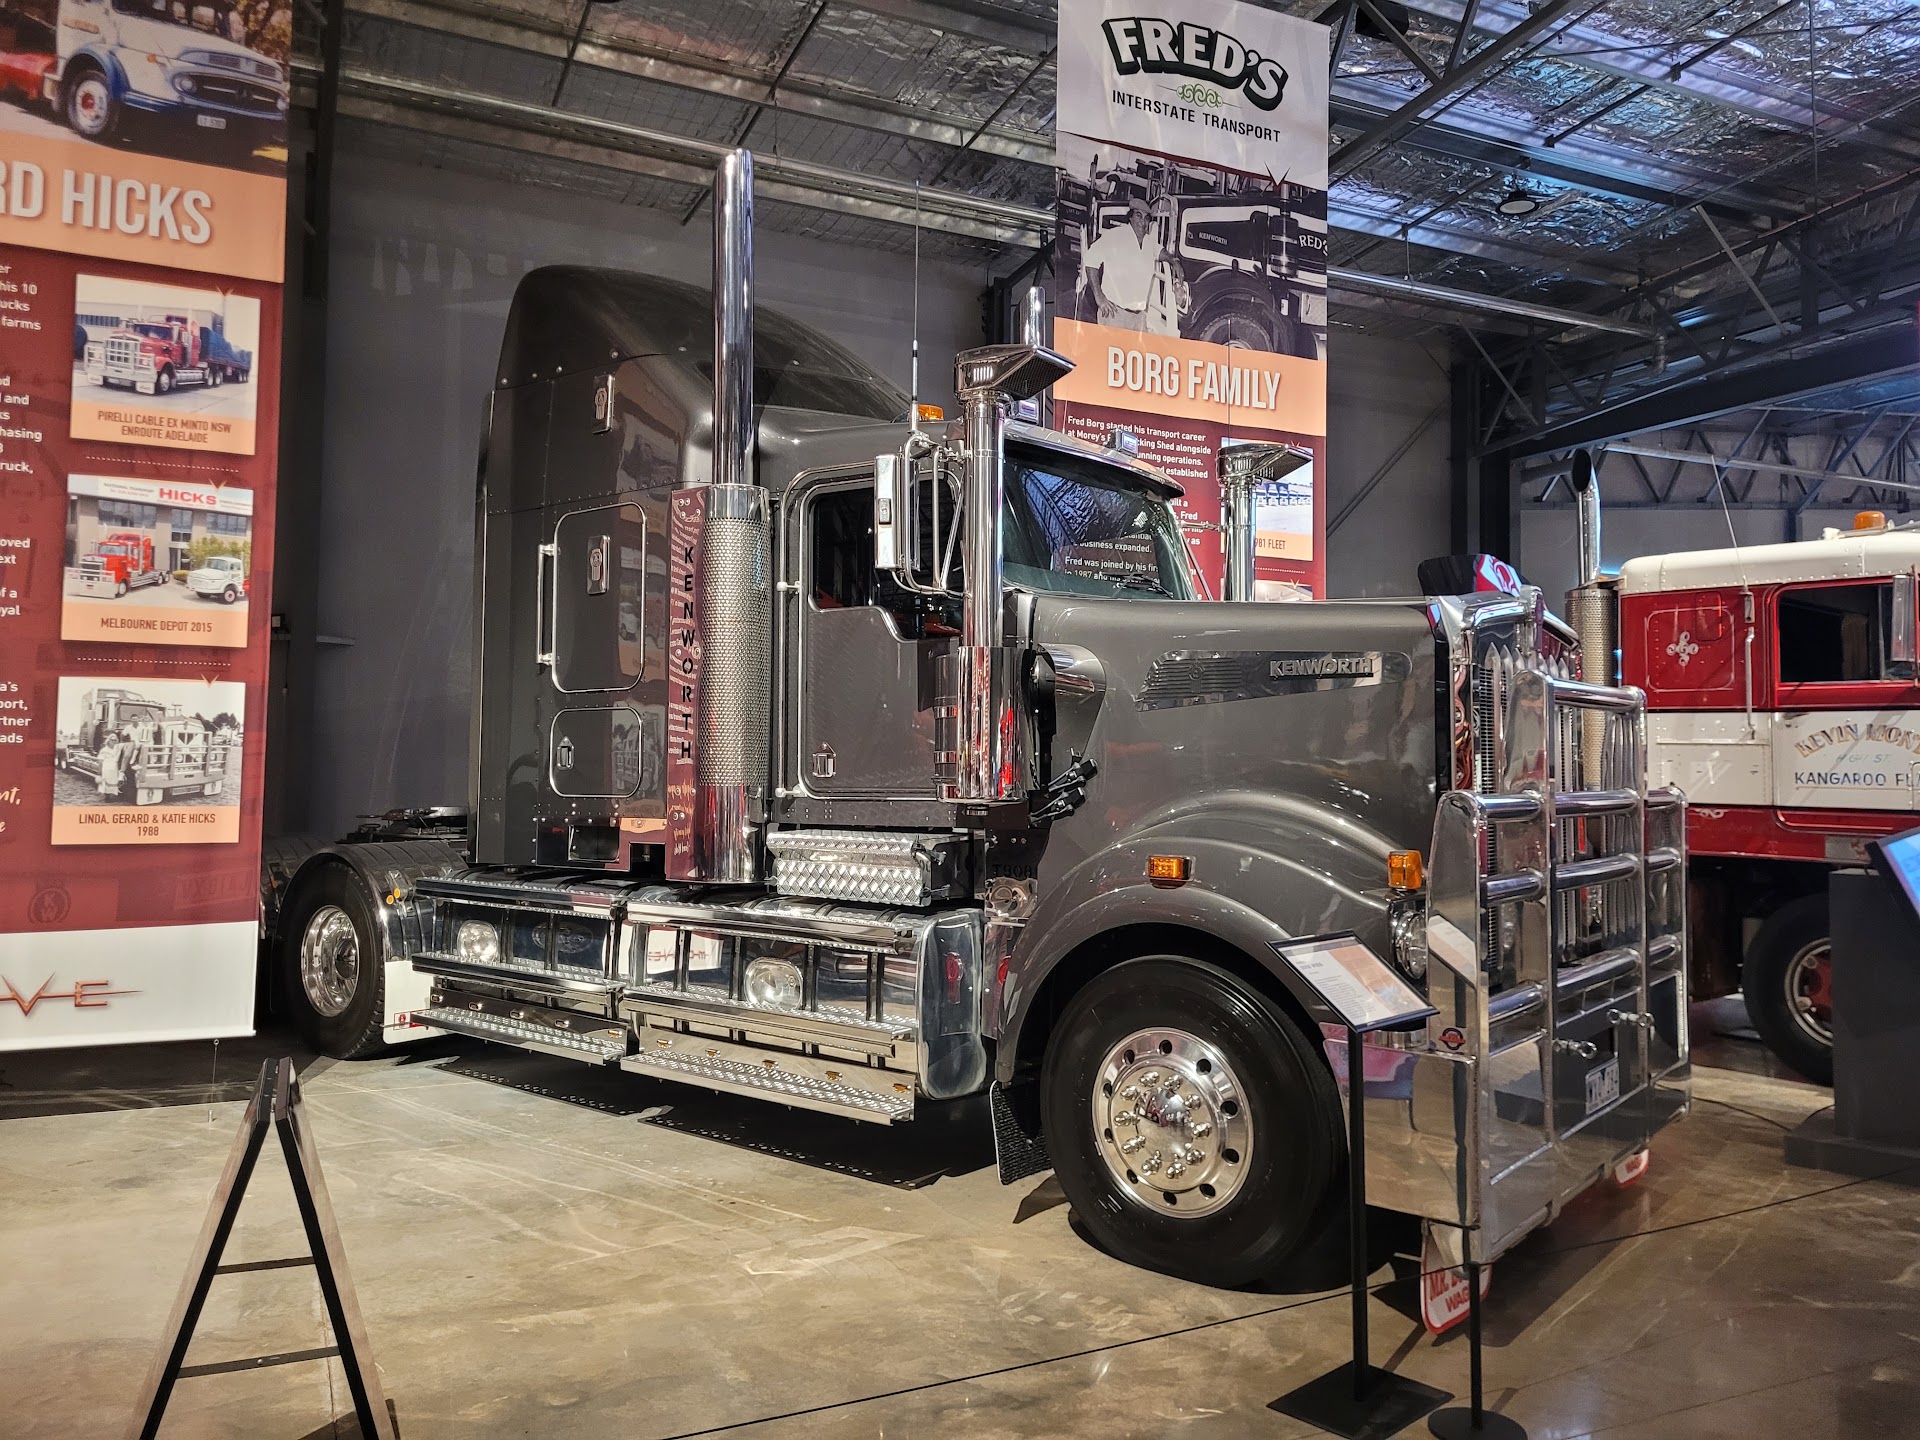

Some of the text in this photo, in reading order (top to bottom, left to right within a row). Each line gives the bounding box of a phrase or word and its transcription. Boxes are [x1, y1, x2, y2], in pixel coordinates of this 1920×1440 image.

[1101, 16, 1288, 111] FRED'S
[1112, 89, 1281, 142] INTERSTATE TRANSPORT
[63, 170, 213, 245] HICKS
[1199, 231, 1228, 246] KENWORTH
[22, 283, 38, 295] 10
[1, 315, 42, 331] farms
[1107, 346, 1281, 410] BORG FAMILY
[4, 394, 30, 405] and
[97, 410, 232, 434] PIRELLI CABLE EX MINTO NSW
[1067, 415, 1206, 442] Fred Borg started his transport career
[122, 426, 209, 444] ENROUTE ADELAIDE
[1067, 429, 1076, 438] at
[1077, 430, 1106, 442] Morey's
[1157, 439, 1175, 450] Shed
[1176, 442, 1212, 455] alongside
[1163, 454, 1204, 466] operations.
[1166, 466, 1209, 479] established
[159, 488, 217, 505] HICKS
[1181, 511, 1198, 520] Fred
[1114, 543, 1153, 554] expanded.
[1190, 537, 1200, 545] as
[1268, 538, 1286, 550] FLEET
[1065, 556, 1083, 566] Fred
[1084, 558, 1100, 567] was
[1100, 558, 1124, 572] joined
[1125, 561, 1135, 573] by
[1135, 562, 1147, 572] his
[1074, 569, 1092, 579] 1987
[9, 590, 18, 598] a
[101, 617, 213, 633] MELBOURNE DEPOT 2015
[681, 546, 695, 760] KENWORTH
[1269, 657, 1374, 678] KENWORTH
[1794, 723, 1859, 758] KEVIN
[1795, 771, 1887, 786] KANGAROO
[112, 813, 149, 824] GERARD
[152, 814, 159, 824] &
[162, 813, 187, 824] KATIE
[188, 813, 216, 824] HICKS
[137, 826, 160, 836] 1988
